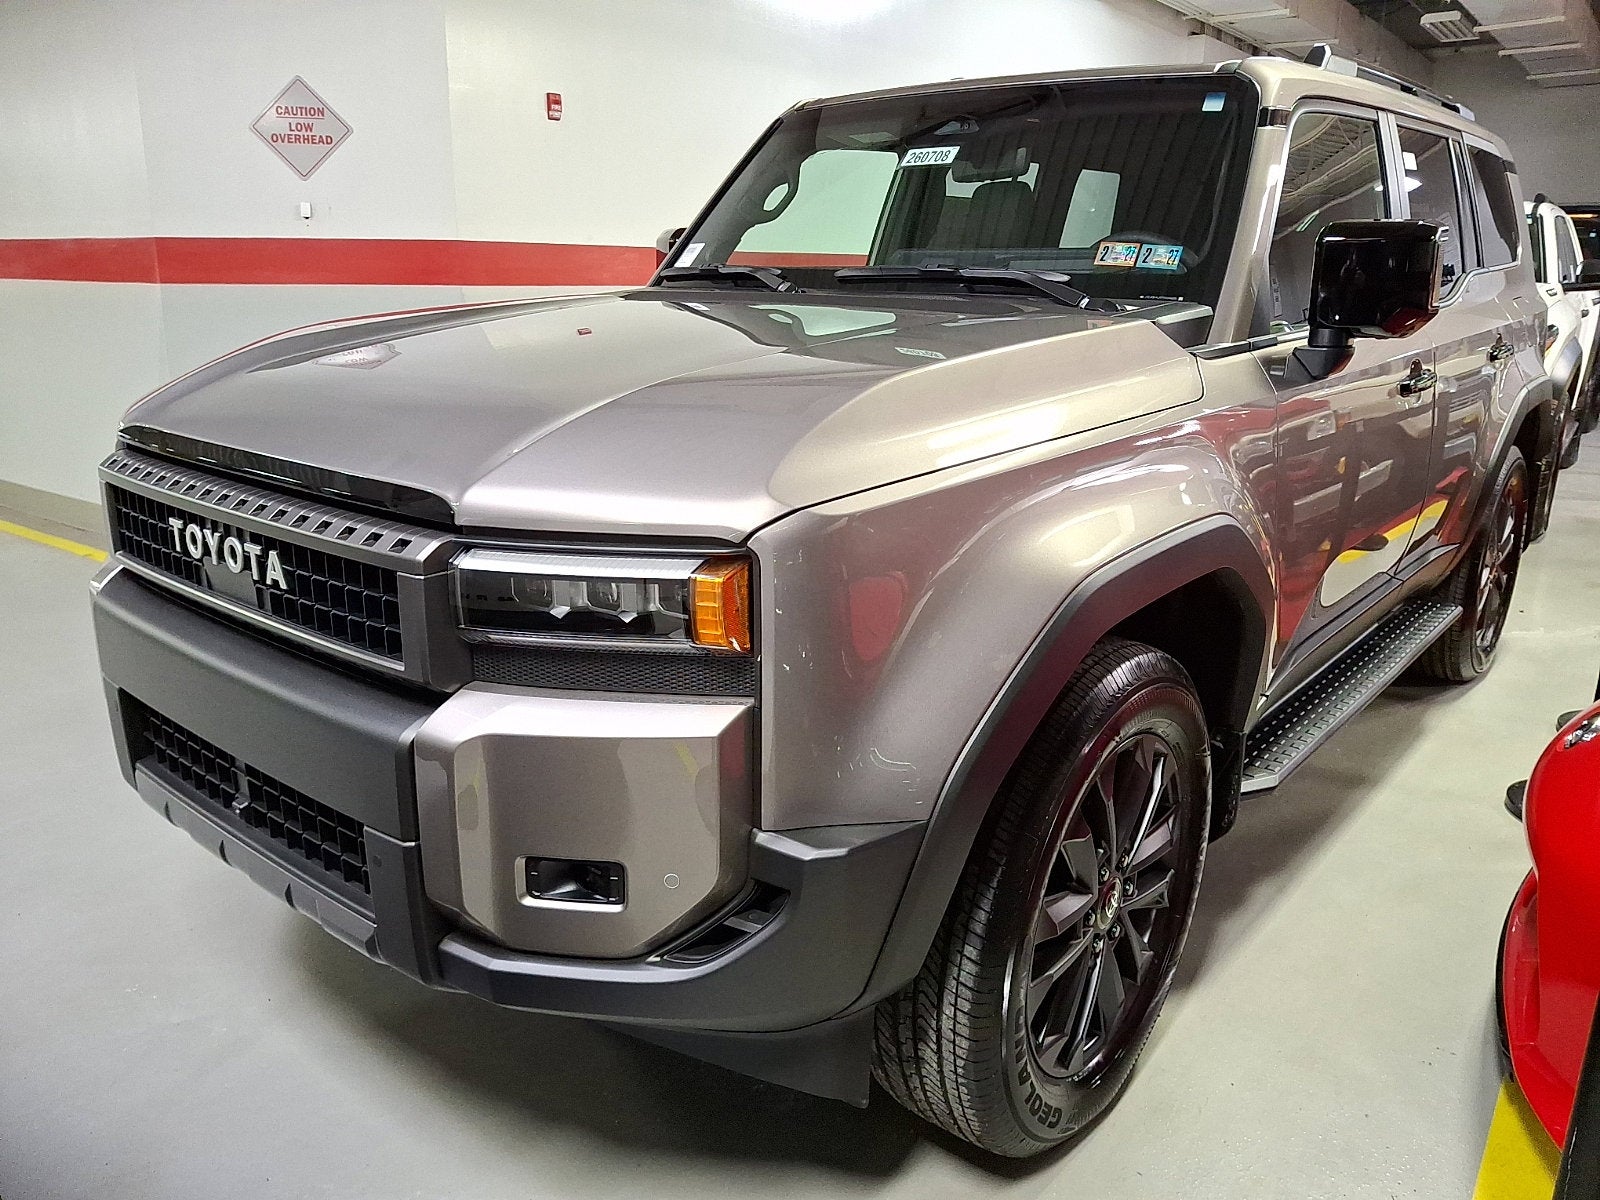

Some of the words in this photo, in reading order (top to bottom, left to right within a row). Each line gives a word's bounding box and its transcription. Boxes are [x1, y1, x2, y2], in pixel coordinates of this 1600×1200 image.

[275, 105, 325, 117] CAUTION
[288, 122, 314, 132] LOW
[270, 133, 334, 145] OVERHEAD
[905, 150, 951, 163] 260708
[1100, 246, 1110, 261] 2
[1124, 246, 1137, 262] 27
[1142, 248, 1153, 263] 2
[1167, 249, 1180, 265] 27
[168, 517, 289, 590] TOYOTA
